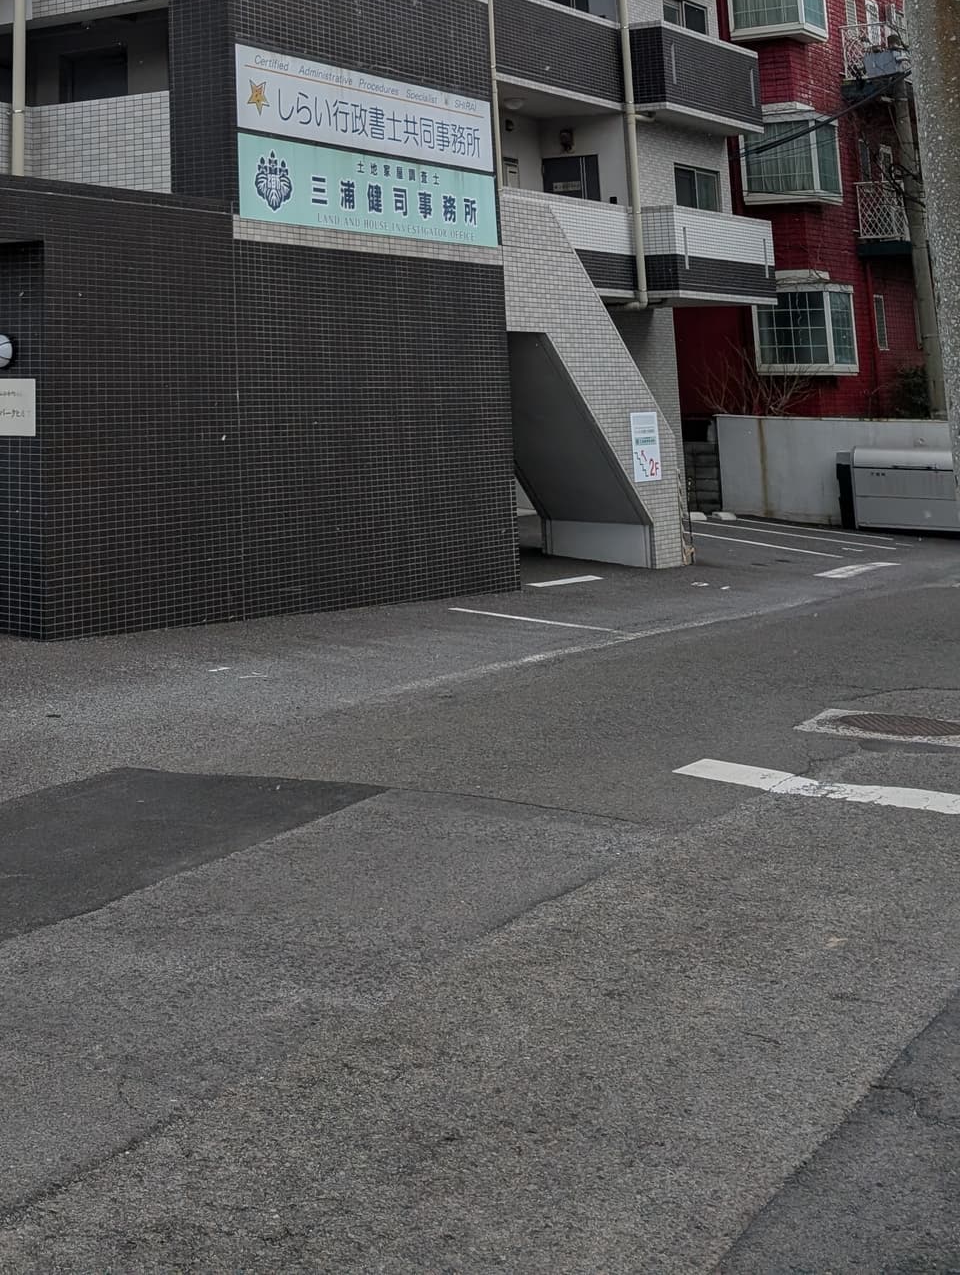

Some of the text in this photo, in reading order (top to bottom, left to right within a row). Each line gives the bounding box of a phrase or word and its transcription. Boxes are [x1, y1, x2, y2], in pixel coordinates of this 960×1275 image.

[255, 55, 477, 111] Certified Administrative Procedures Specialist SHIRAI
[278, 88, 480, 158] しらい行政書士共同事務所
[311, 176, 478, 225] 三浦健司事務所
[317, 213, 475, 241] LAND AND HOUSE INVESTIGATOR OFFICE
